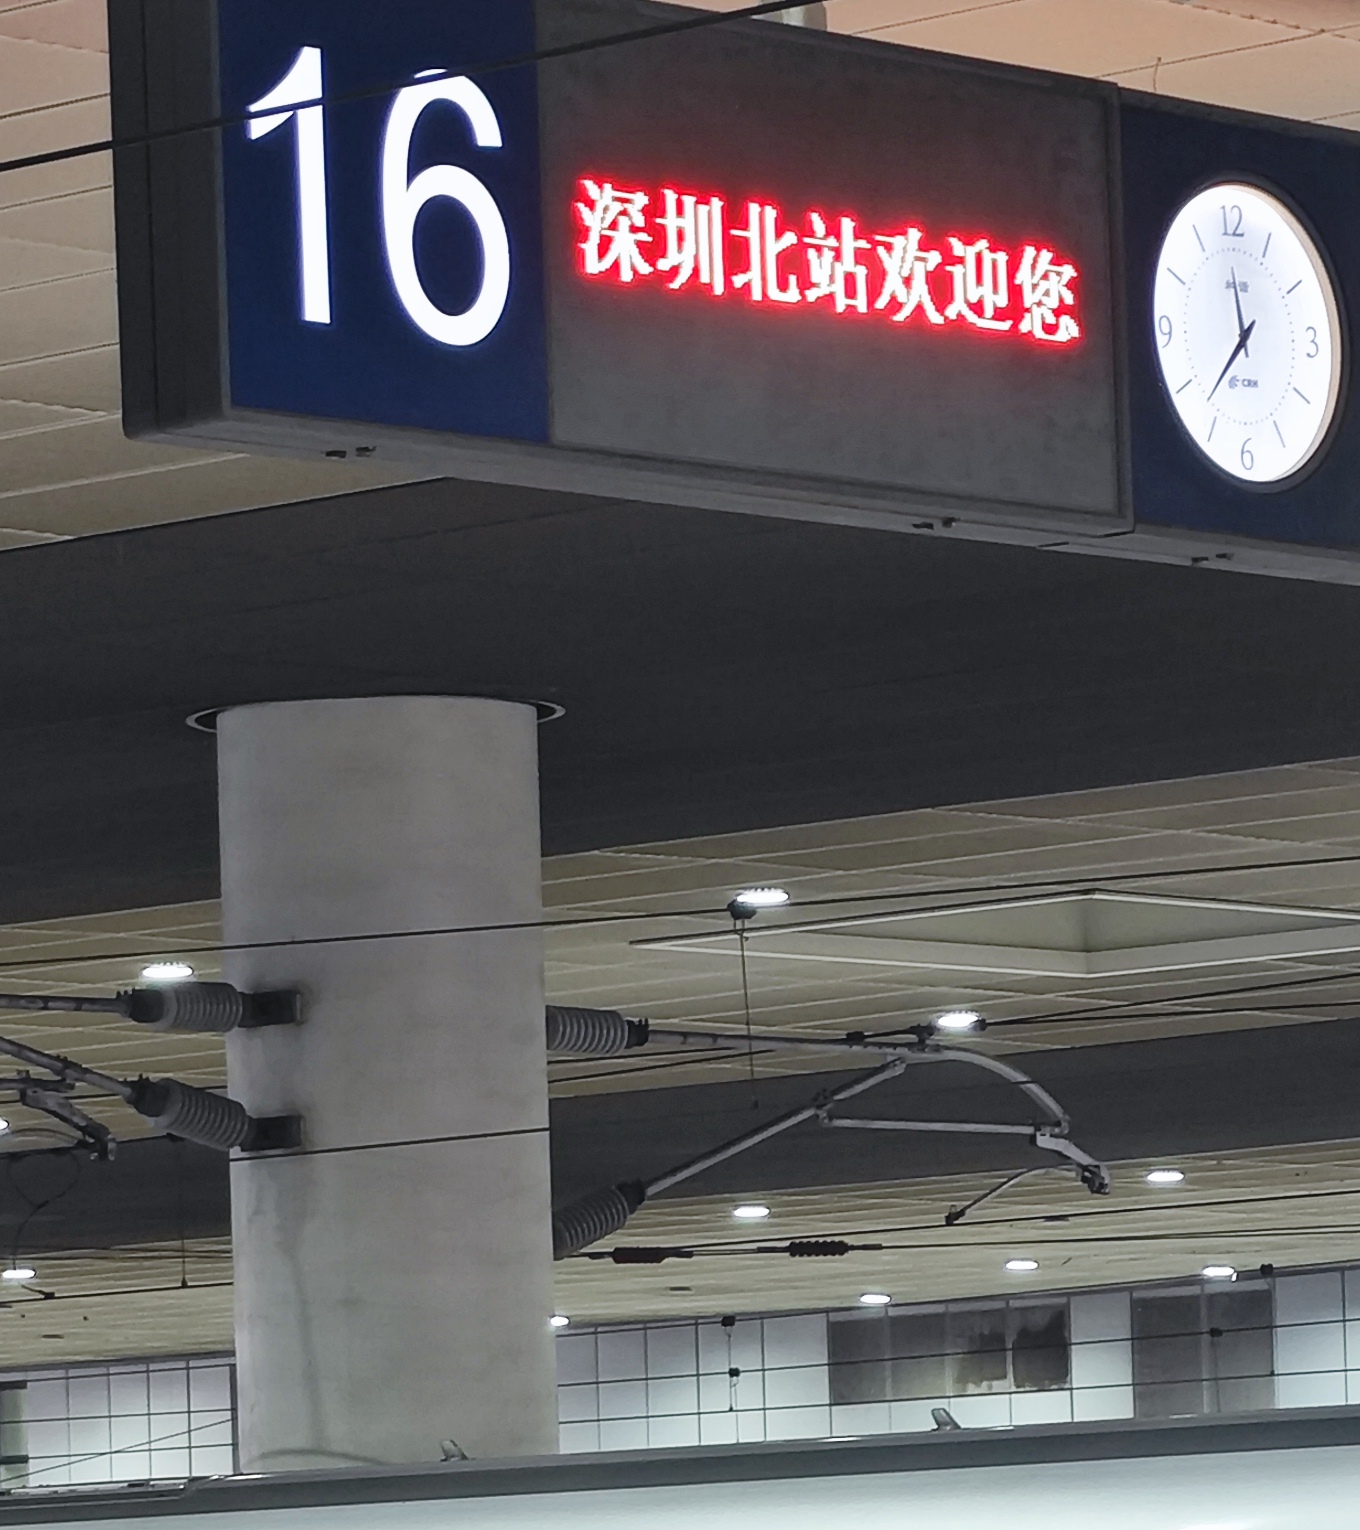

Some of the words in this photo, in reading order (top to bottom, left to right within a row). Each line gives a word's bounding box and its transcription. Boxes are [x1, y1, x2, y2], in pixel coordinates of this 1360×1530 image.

[247, 46, 510, 346] 16
[1220, 205, 1245, 238] 12
[576, 178, 1081, 344] 深圳北站欢迎您
[1158, 315, 1173, 349] 9
[1305, 326, 1319, 358] 3
[1240, 437, 1254, 471] 6
